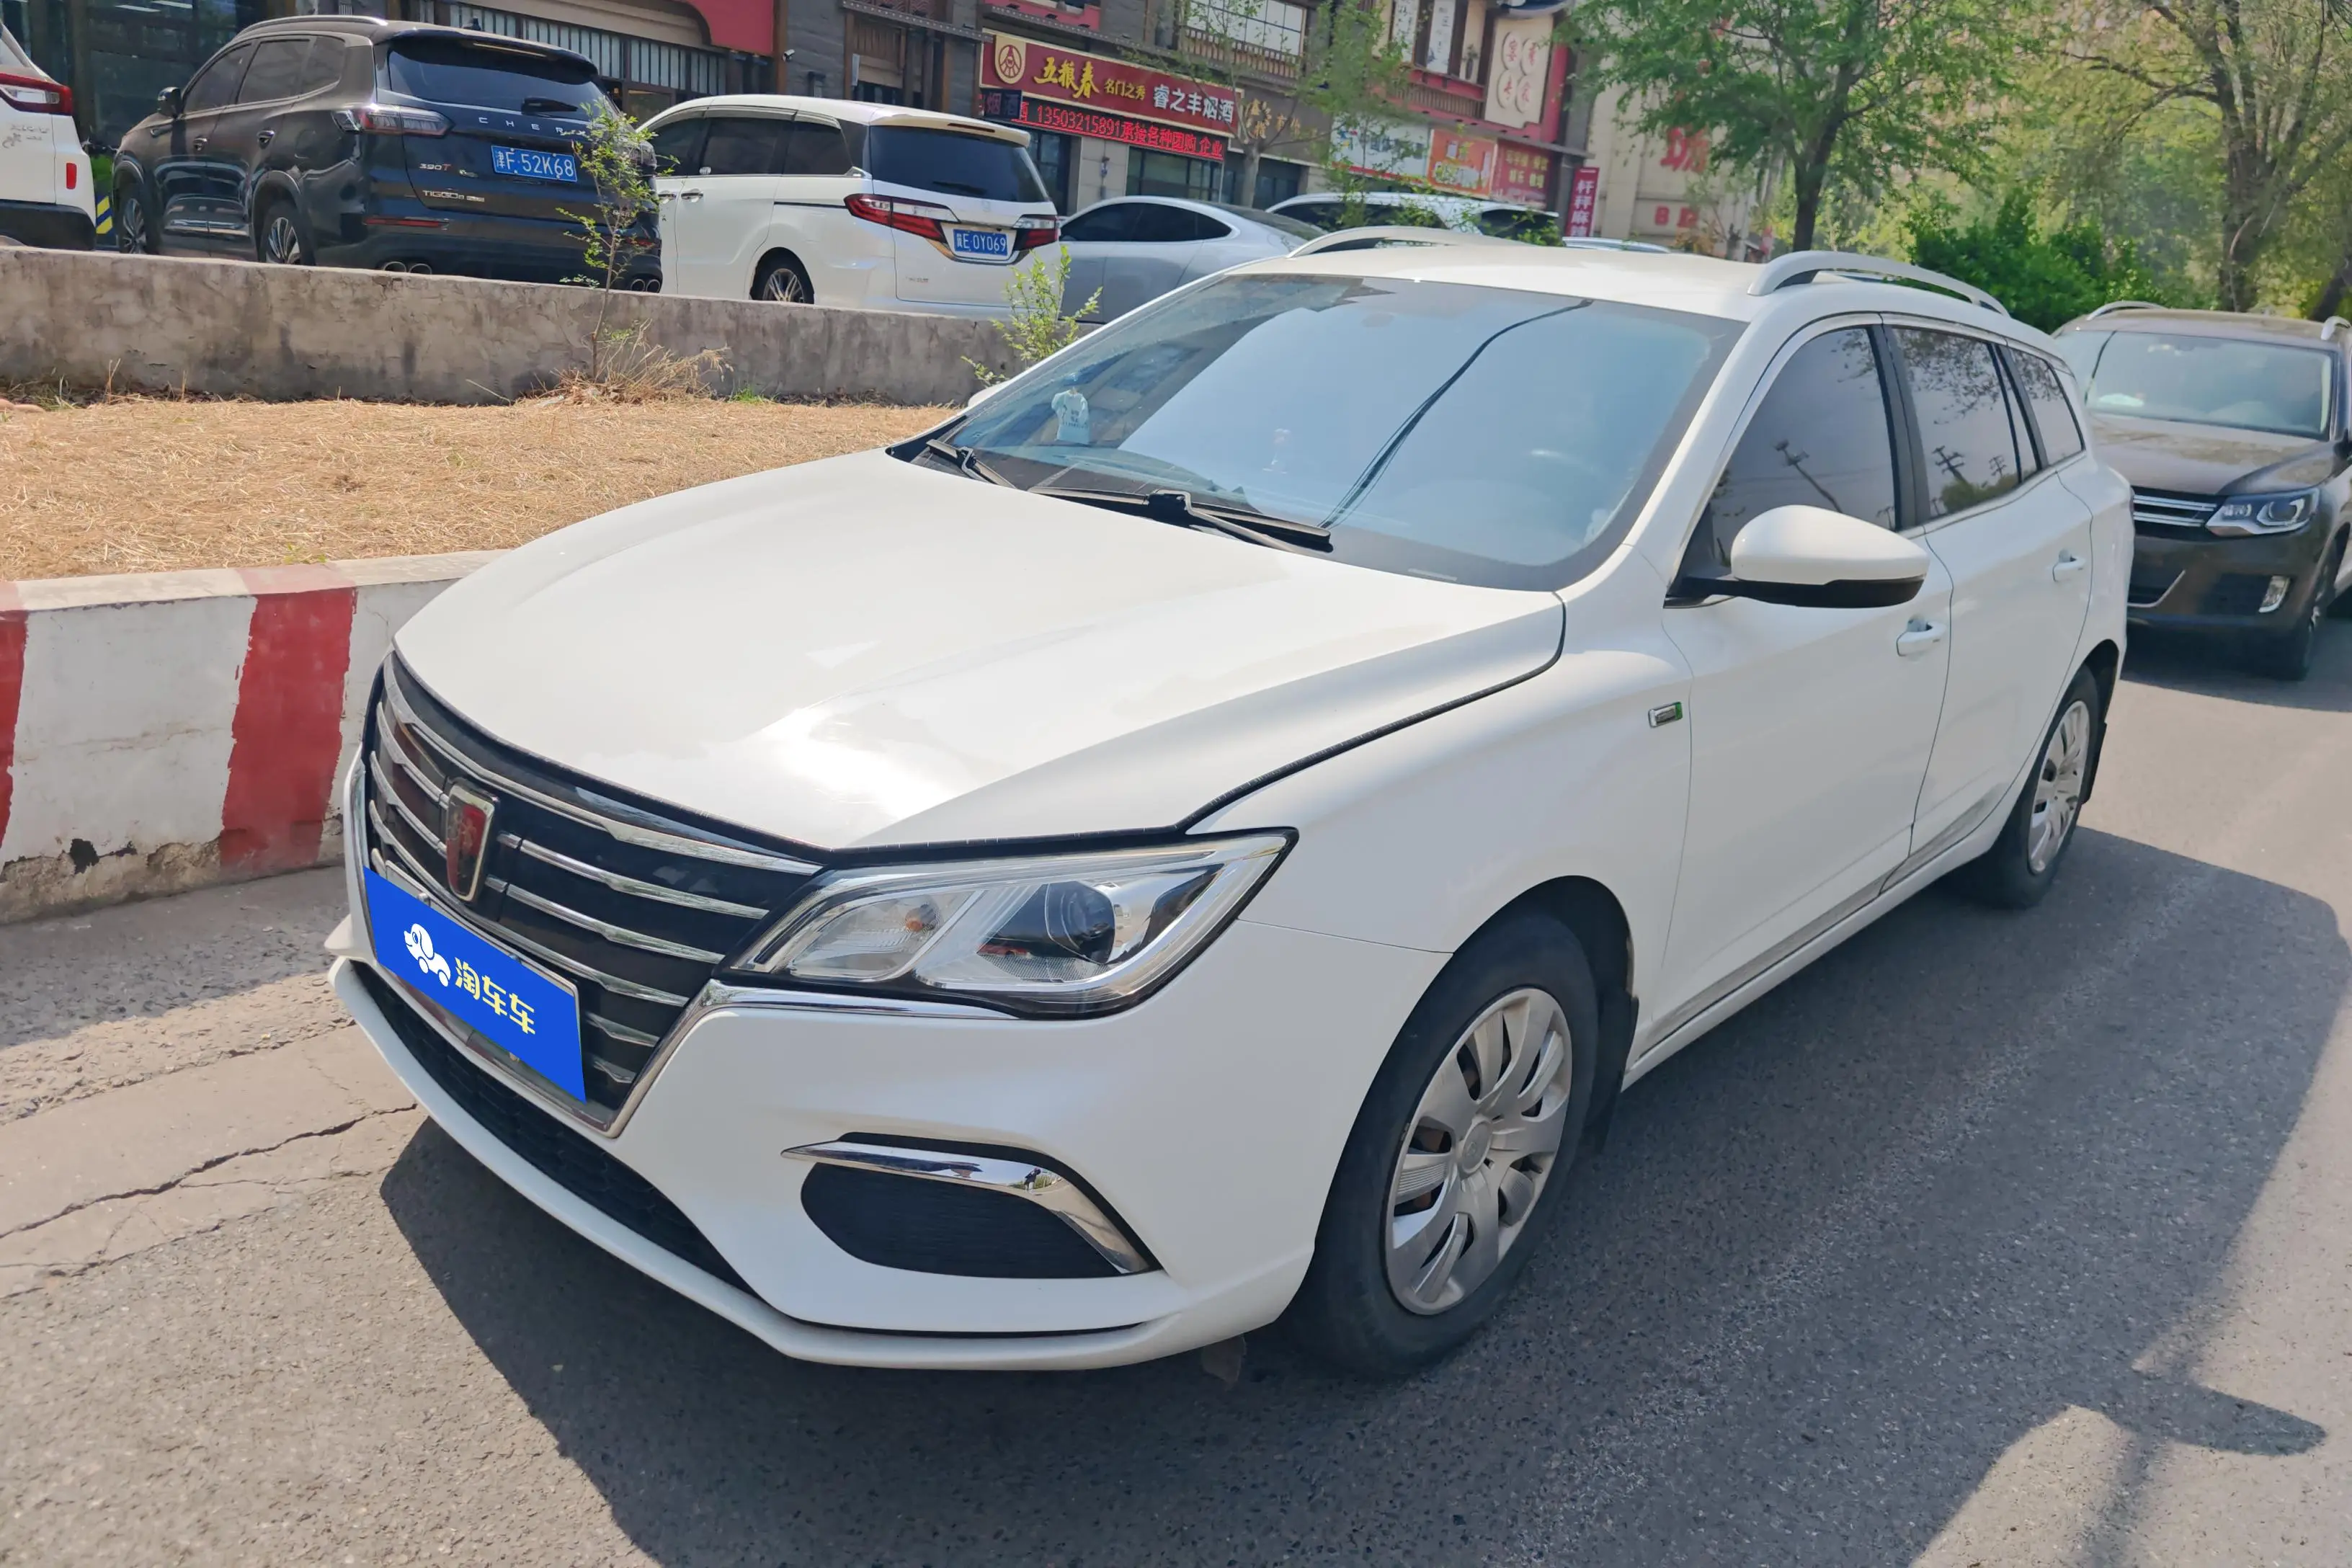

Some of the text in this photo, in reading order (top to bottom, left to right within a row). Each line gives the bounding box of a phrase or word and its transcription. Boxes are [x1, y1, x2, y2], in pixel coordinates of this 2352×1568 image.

[1033, 57, 1100, 98] 五粮春
[1104, 78, 1146, 101] 名门之秀
[1153, 84, 1234, 124] 睿之丰烟酒
